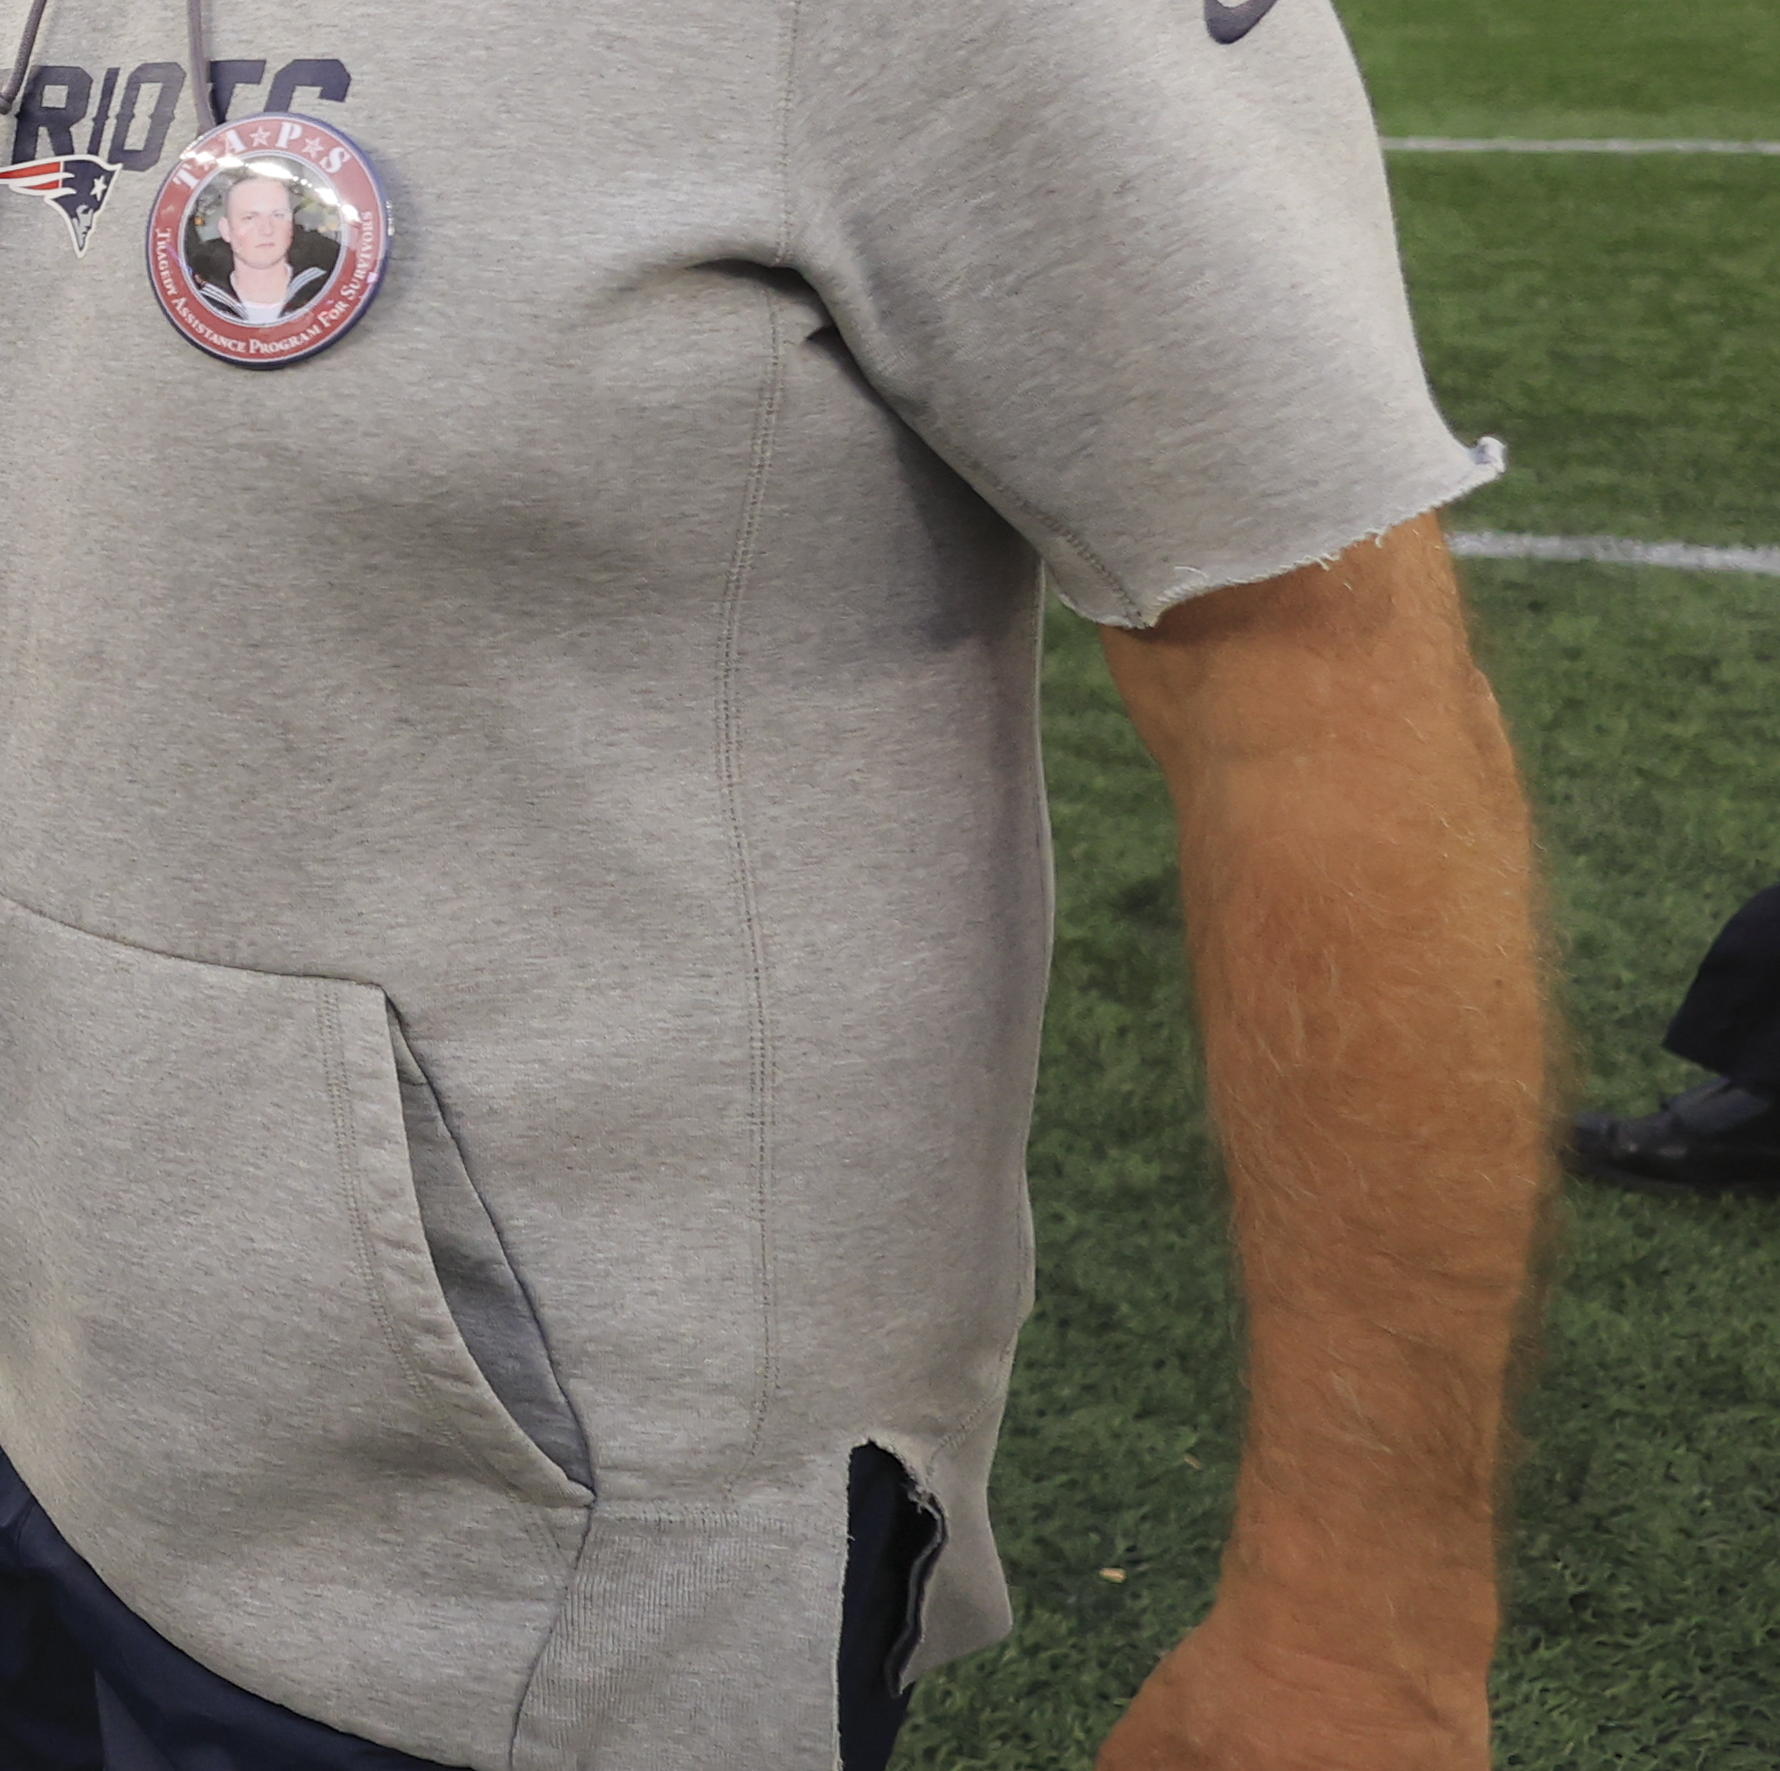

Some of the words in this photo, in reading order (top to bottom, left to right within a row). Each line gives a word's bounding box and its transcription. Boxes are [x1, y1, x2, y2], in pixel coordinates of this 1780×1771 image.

[155, 227, 178, 297] TRAGEDY
[172, 296, 246, 354] ASSISTANCE
[248, 324, 322, 355] PROGRAM
[317, 299, 351, 329] FOR
[339, 211, 375, 302] SURVIVORS
